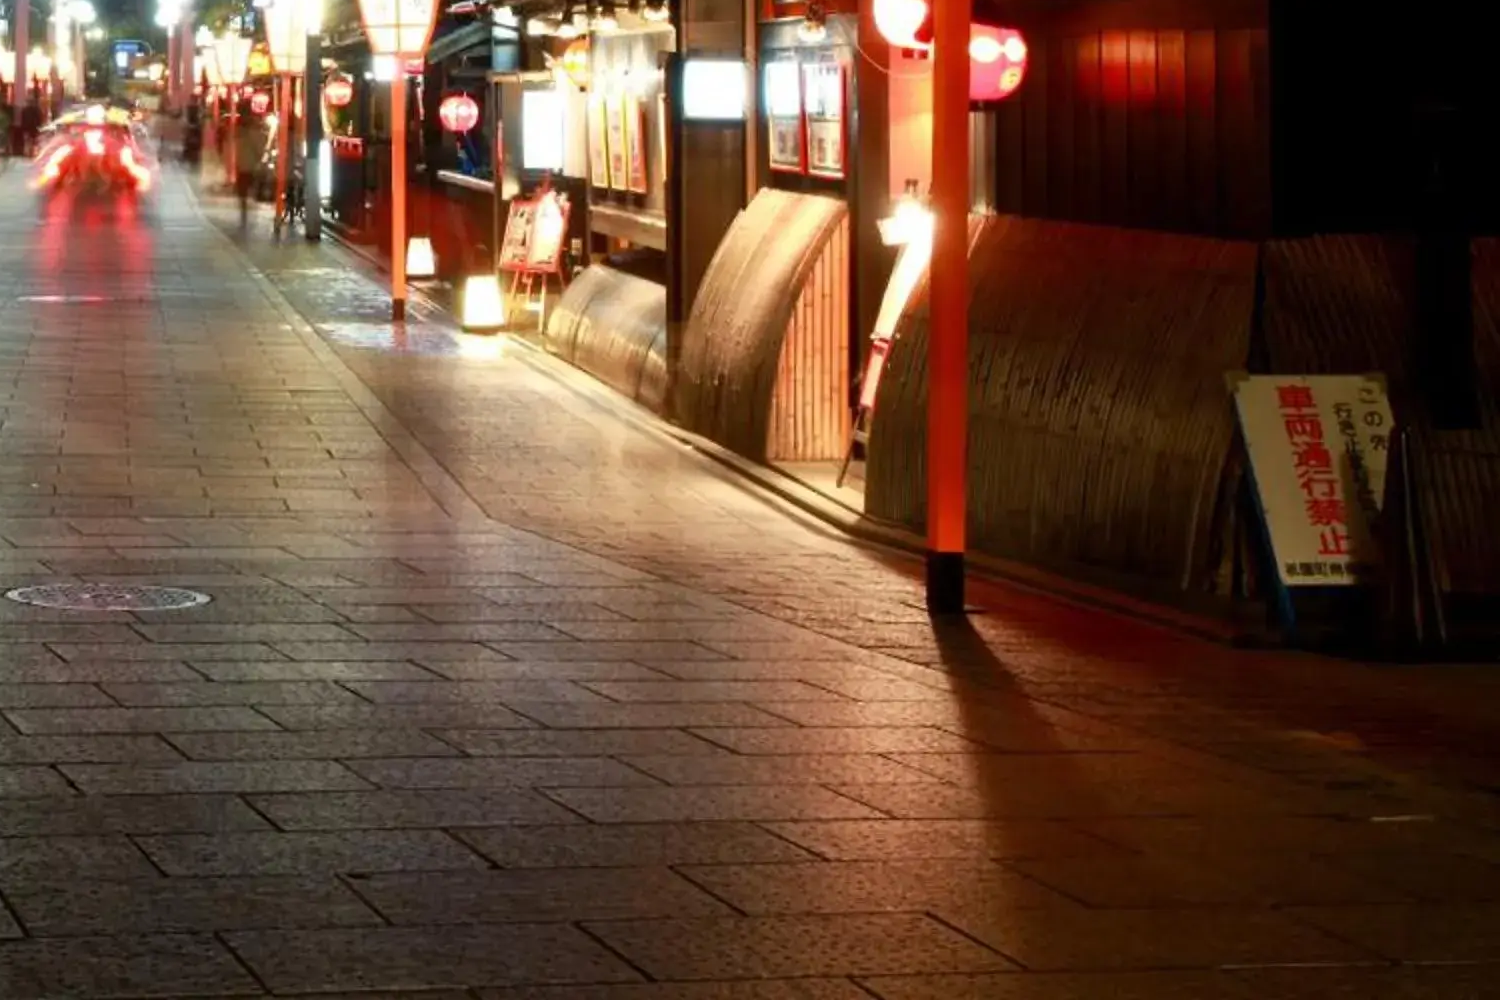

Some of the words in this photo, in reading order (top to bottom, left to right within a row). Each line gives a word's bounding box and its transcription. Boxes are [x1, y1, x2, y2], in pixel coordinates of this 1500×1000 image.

[1276, 384, 1354, 555] 車両通行禁止
